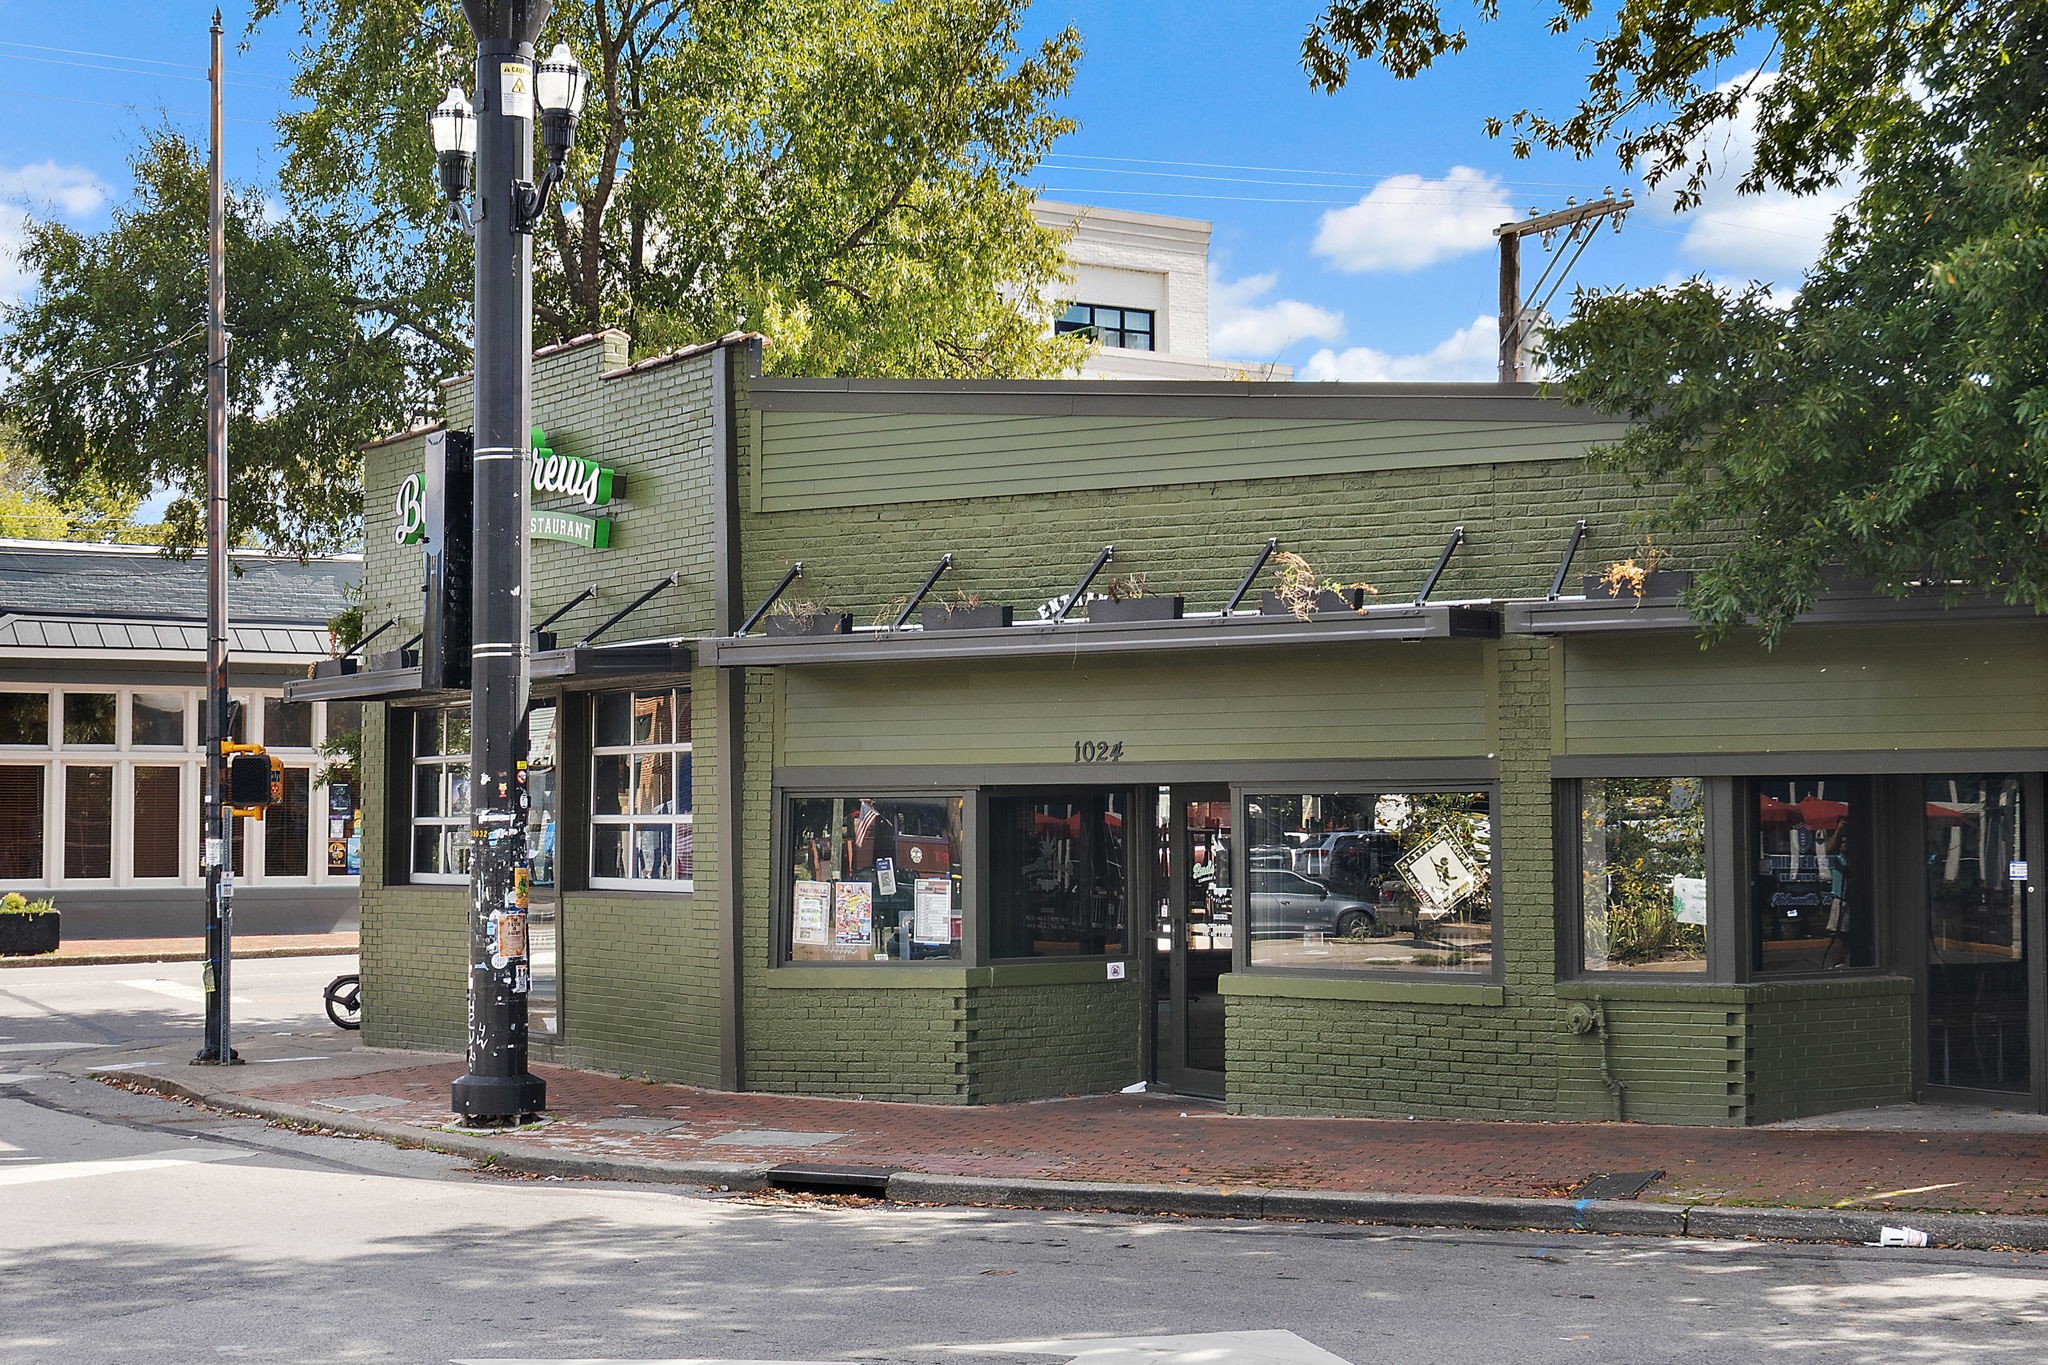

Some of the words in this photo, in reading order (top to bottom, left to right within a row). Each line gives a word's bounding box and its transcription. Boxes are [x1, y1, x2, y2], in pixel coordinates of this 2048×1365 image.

[530, 447, 600, 504] rews
[530, 518, 591, 540] STAURANT
[1075, 741, 1124, 762] 1024
[1406, 832, 1442, 864] LITTLE
